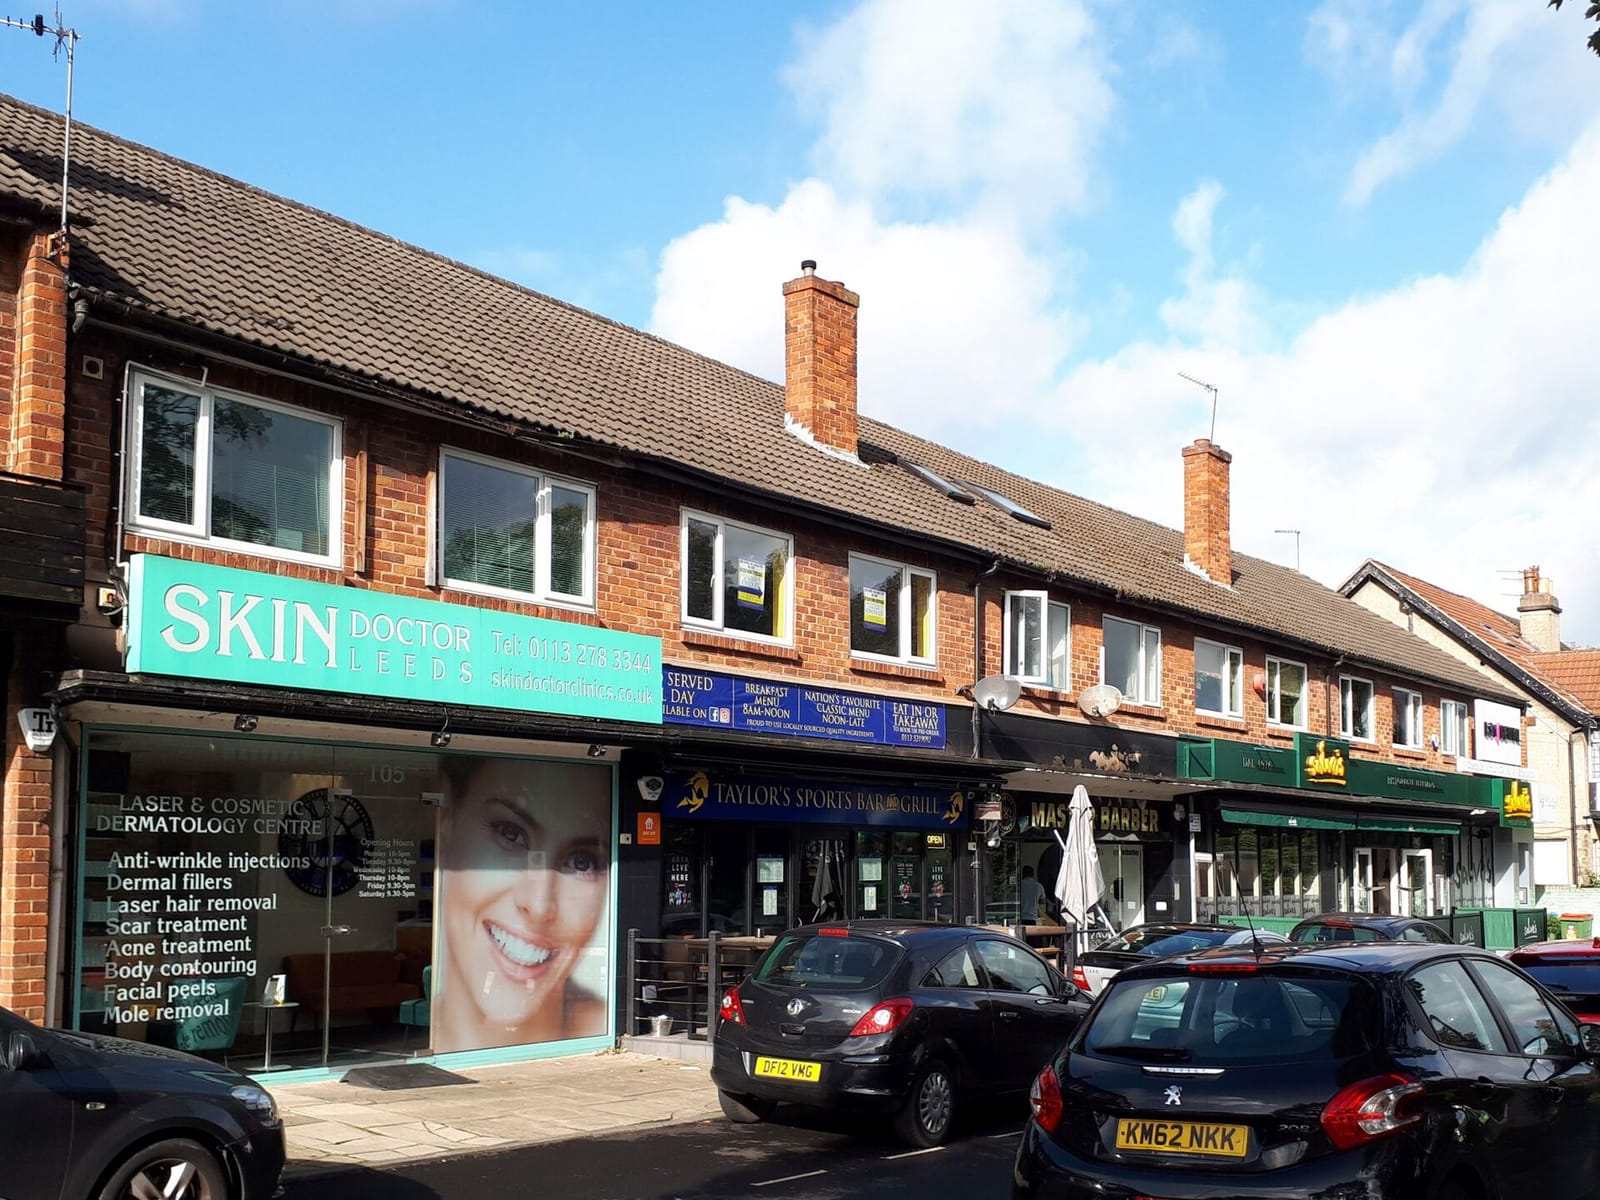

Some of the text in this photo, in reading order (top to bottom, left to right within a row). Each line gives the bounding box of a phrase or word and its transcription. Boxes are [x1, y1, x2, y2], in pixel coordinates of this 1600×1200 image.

[160, 582, 471, 669] SKIN DOCTOR
[491, 631, 652, 674] Tel: 0113 278 3344
[350, 647, 473, 684] LEEDS
[491, 667, 653, 705] skindoctorclinics.co.uk
[667, 672, 713, 691] SERVED
[745, 683, 789, 698] BREAKFAST
[671, 688, 695, 705] DAY
[754, 696, 780, 707] MENU
[805, 692, 881, 710] NATION'S FAVOURITE
[692, 708, 707, 718] ON
[742, 703, 791, 719] 8AM-NOON
[816, 703, 870, 718] CLASSIC MENU
[893, 702, 939, 718] EAT IN OR
[822, 714, 865, 728] NOON-LATE
[892, 713, 939, 730] TAKEAWAY
[119, 794, 304, 816] LASER & COSMETIC
[714, 783, 791, 806] TAYLOR'S
[796, 788, 852, 810] SPORTS
[857, 792, 884, 811] BAR
[900, 795, 939, 814] GRILL
[96, 815, 323, 836] DERMATOLOGY CENTRE
[1100, 806, 1159, 832] BARBER
[360, 838, 391, 848] Opening
[927, 835, 943, 844] OPEN
[107, 851, 311, 873] Anti-wrinkle injections
[106, 873, 233, 891] Dermal fillers
[358, 874, 386, 882] Thursday
[367, 882, 386, 890] Friday
[106, 893, 278, 914] Laser hair removal
[358, 890, 386, 899] Saturday
[106, 915, 248, 936] Scar treatment
[105, 936, 252, 957] Acne treatment
[104, 957, 257, 980] Body contouring
[104, 979, 216, 1002] Facial peels
[103, 999, 230, 1024] Mole removal
[763, 1060, 813, 1078] DF12 VMG
[1125, 1122, 1236, 1151] KM62 NKK
